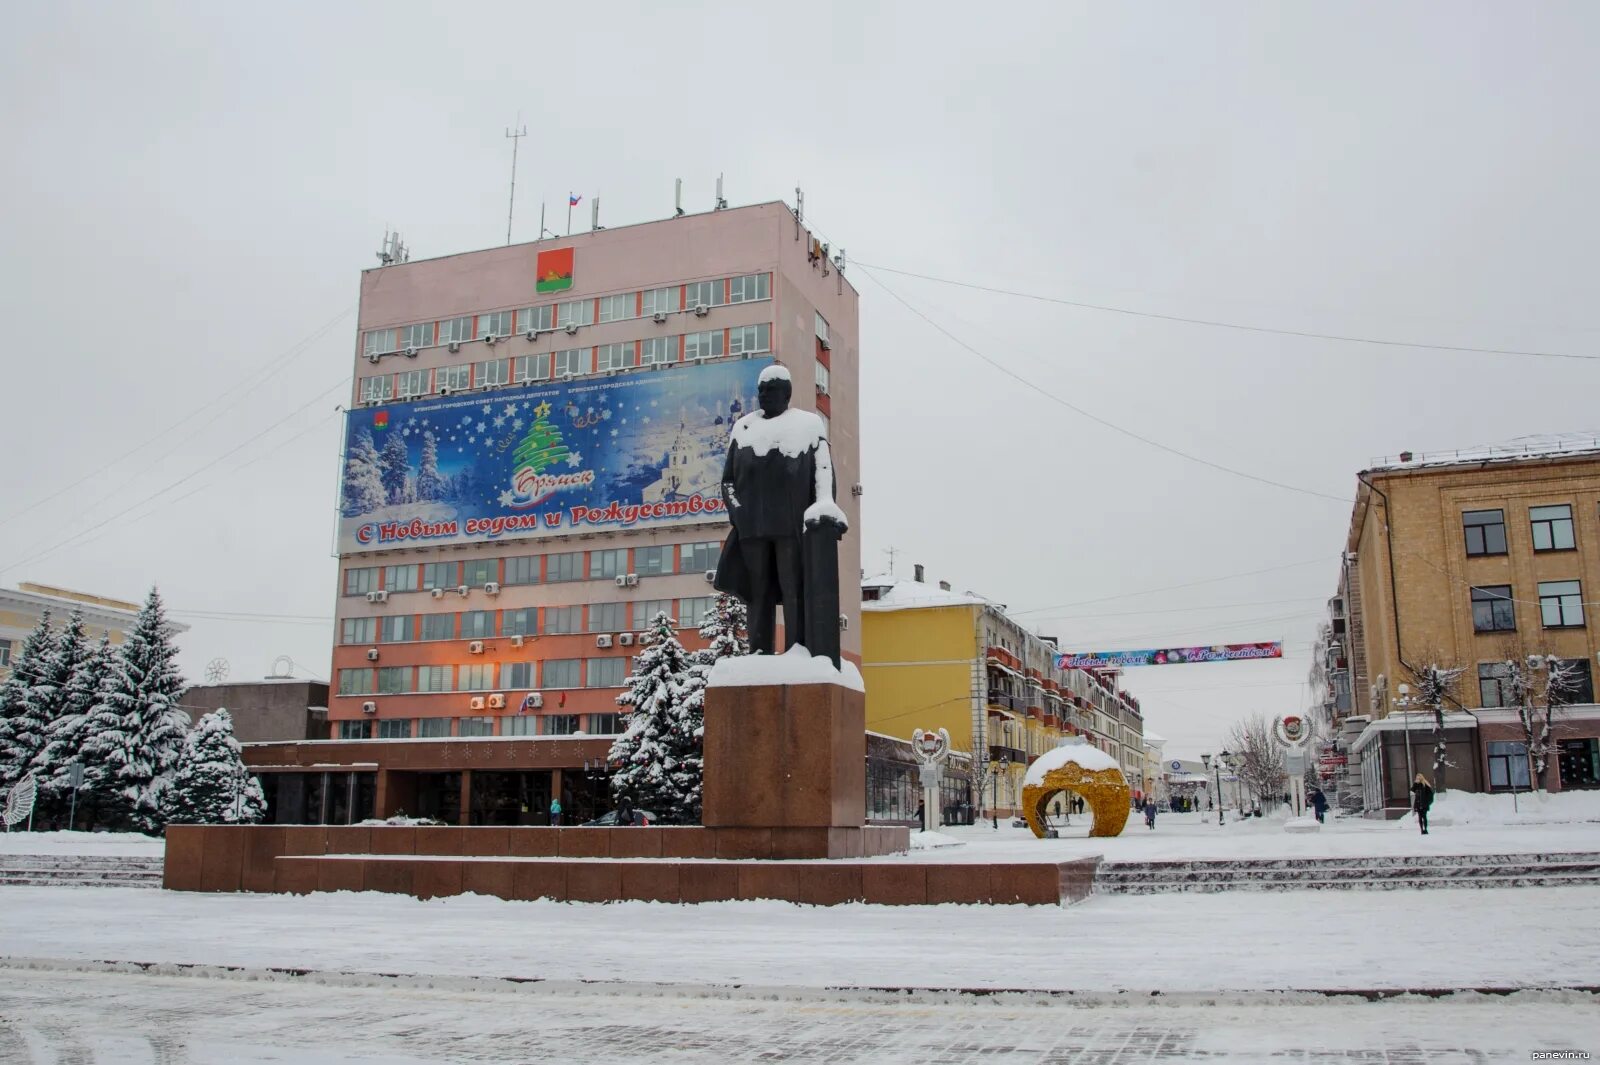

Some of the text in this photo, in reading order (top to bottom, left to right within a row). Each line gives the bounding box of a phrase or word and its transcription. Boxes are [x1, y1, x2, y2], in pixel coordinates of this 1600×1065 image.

[599, 381, 634, 389] ГОРОДСКАЯ
[442, 400, 475, 409] ГОРОДСКОЙ
[526, 390, 560, 399] ДЕПУТАТОВ
[513, 466, 594, 498] Брянск
[379, 516, 457, 541] Новым
[466, 514, 536, 536] годом
[546, 512, 561, 527] и
[1067, 656, 1108, 667] Новым
[1111, 654, 1147, 665] годом!
[1198, 646, 1276, 660] Рождеством!
